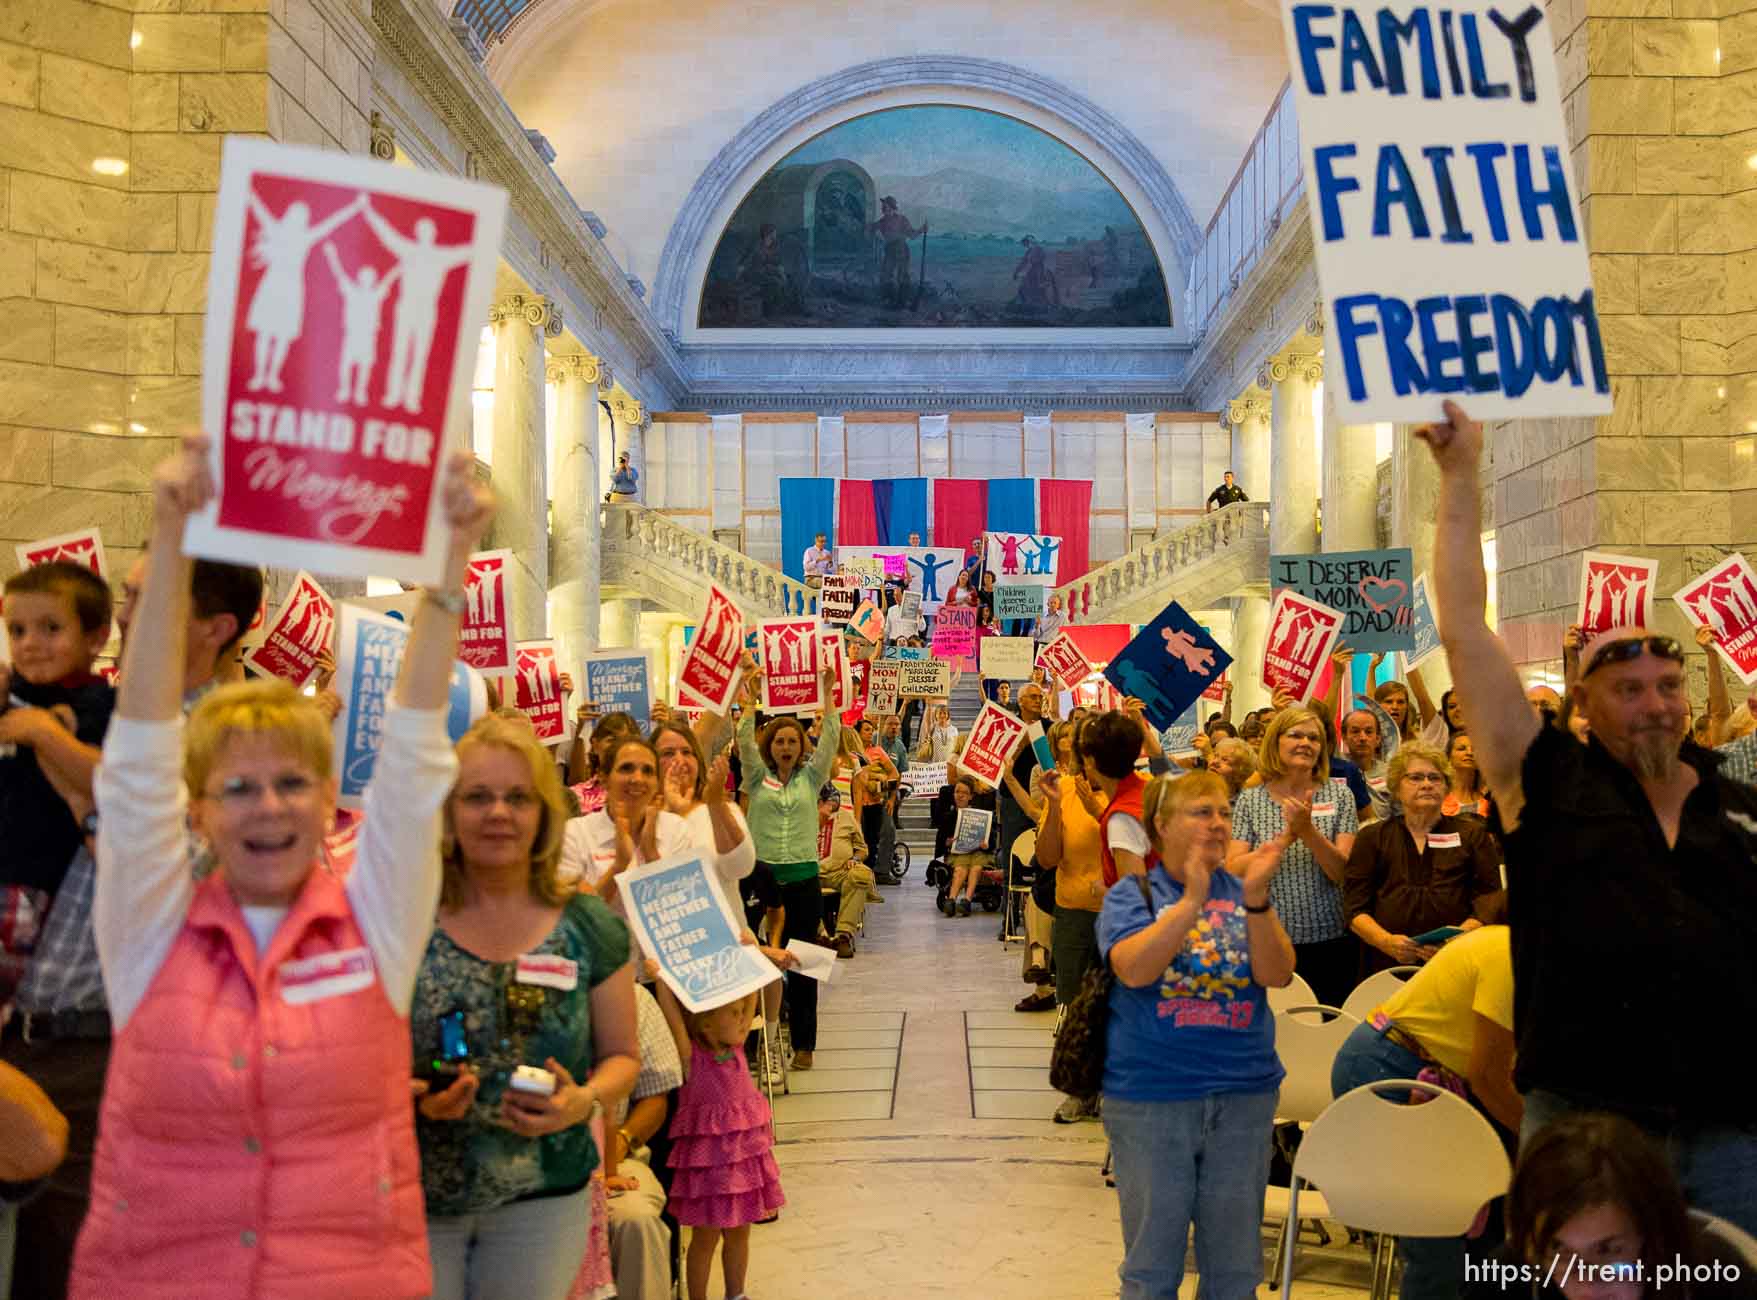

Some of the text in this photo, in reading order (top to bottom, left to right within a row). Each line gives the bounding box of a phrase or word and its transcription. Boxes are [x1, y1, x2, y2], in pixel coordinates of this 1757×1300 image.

[1292, 4, 1543, 102] FAMILY
[1314, 143, 1578, 243] FAITH
[1334, 288, 1610, 401] FREEDOM
[230, 400, 436, 468] STAND FOR
[1278, 559, 1400, 585] I DESERVE
[822, 590, 853, 604] FAITH
[997, 587, 1026, 596] Children
[1315, 587, 1368, 609] MOM
[938, 608, 976, 629] STAND
[480, 627, 503, 640] FOR
[1725, 629, 1755, 654] STAND
[271, 631, 316, 668] STAND FOR
[887, 647, 897, 658] 2
[692, 646, 732, 681] STAND FOR
[872, 669, 897, 677] MOM
[1266, 653, 1312, 680] STAND FOR
[769, 674, 816, 686] STAND FOR
[873, 683, 896, 691] DAD
[902, 685, 943, 694] CHILDREN!
[542, 702, 560, 715] FOR
[970, 743, 990, 759] STAND
[642, 892, 688, 914] MEANS
[657, 897, 712, 923] MOTHER
[653, 921, 682, 941] AND
[660, 928, 708, 954] FATHER
